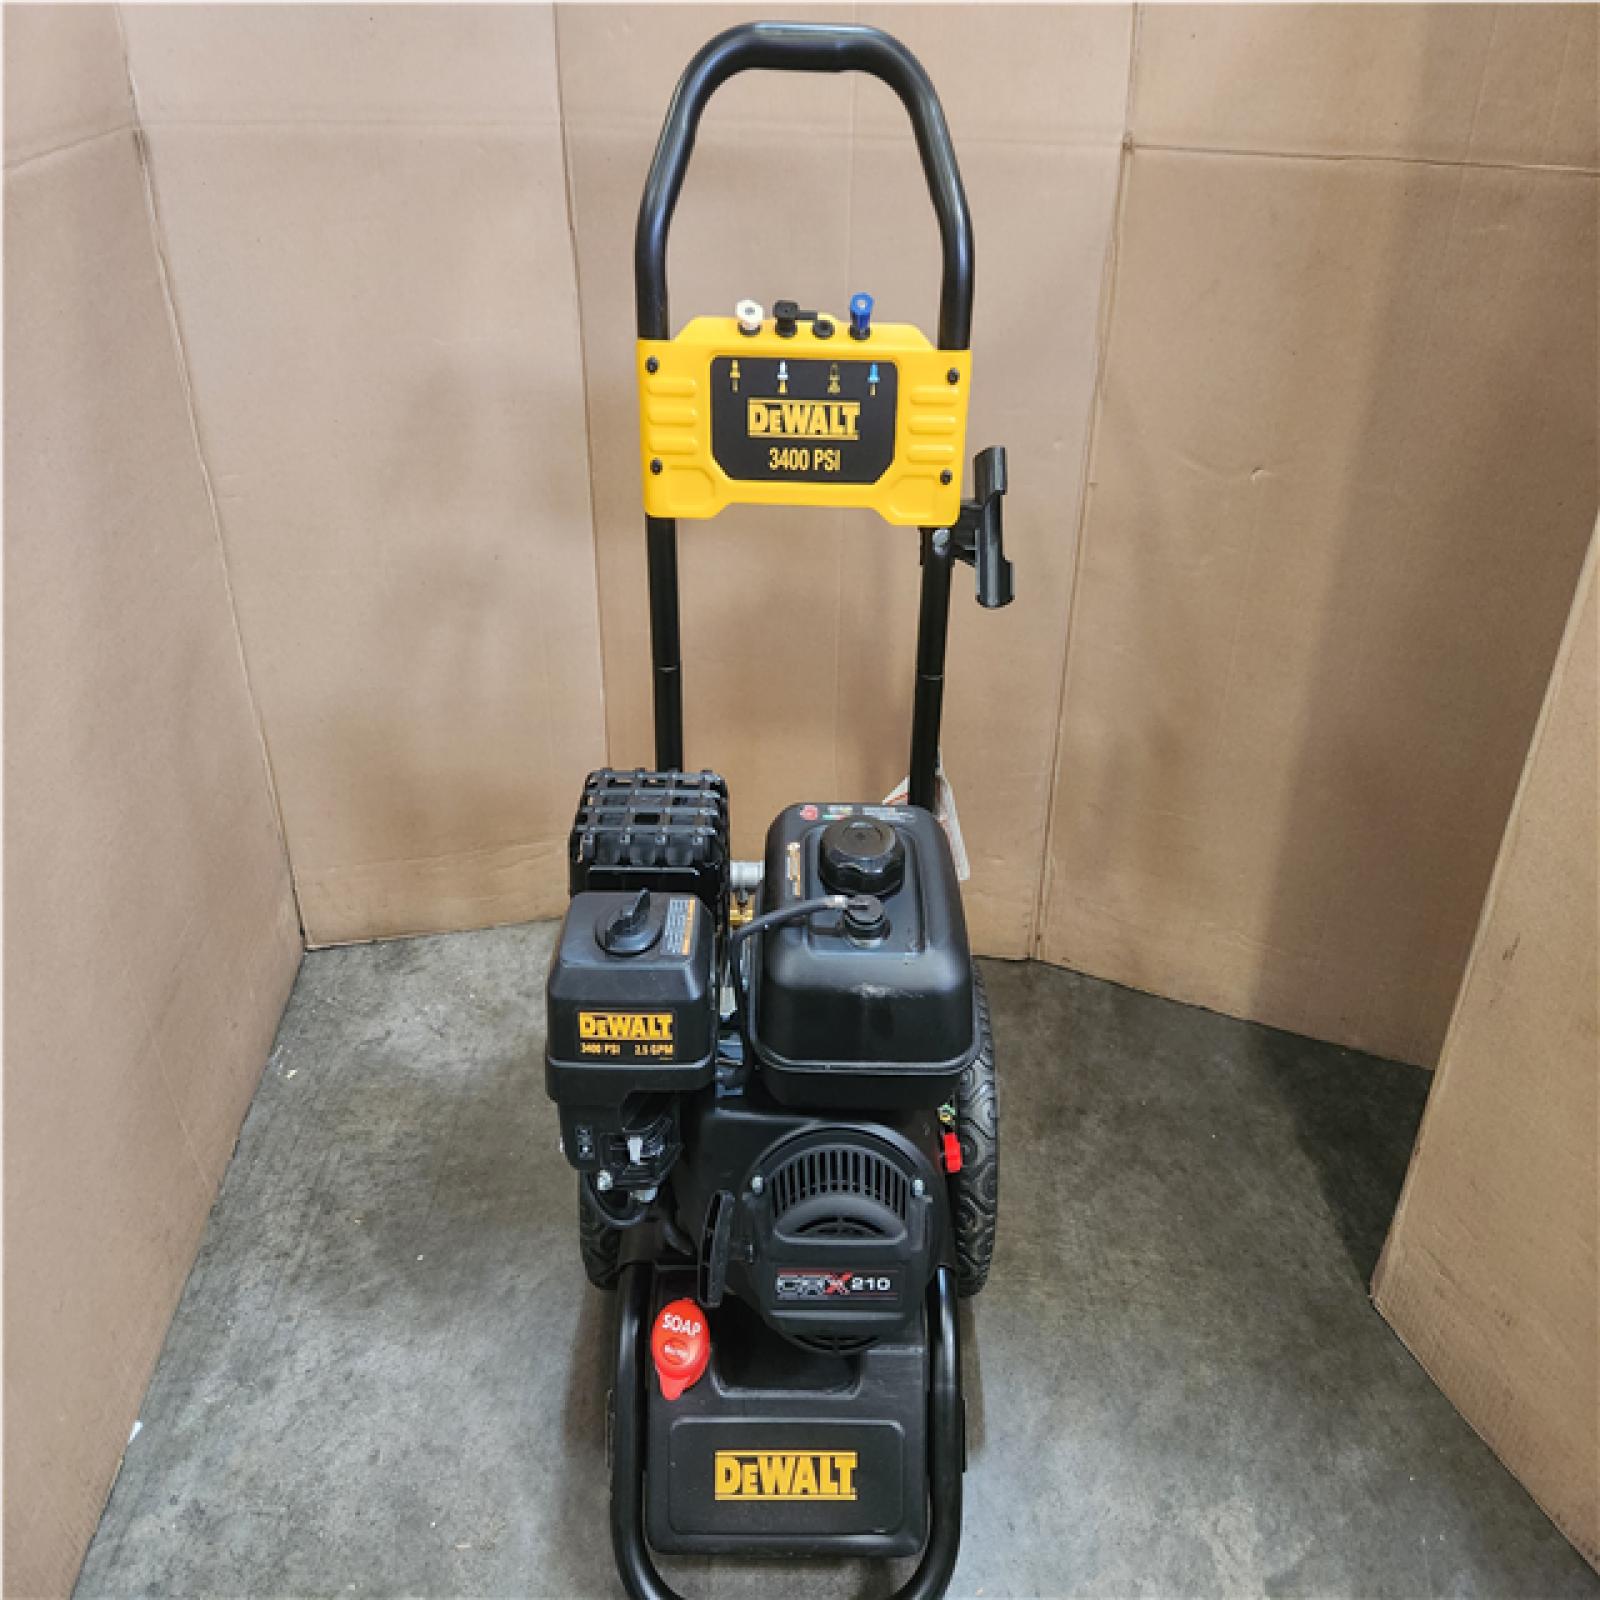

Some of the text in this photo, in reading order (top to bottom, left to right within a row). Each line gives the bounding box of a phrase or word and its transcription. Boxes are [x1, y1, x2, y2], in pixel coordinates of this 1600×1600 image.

[768, 446, 841, 471] 3400 PSI
[662, 1312, 702, 1336] SOAP
